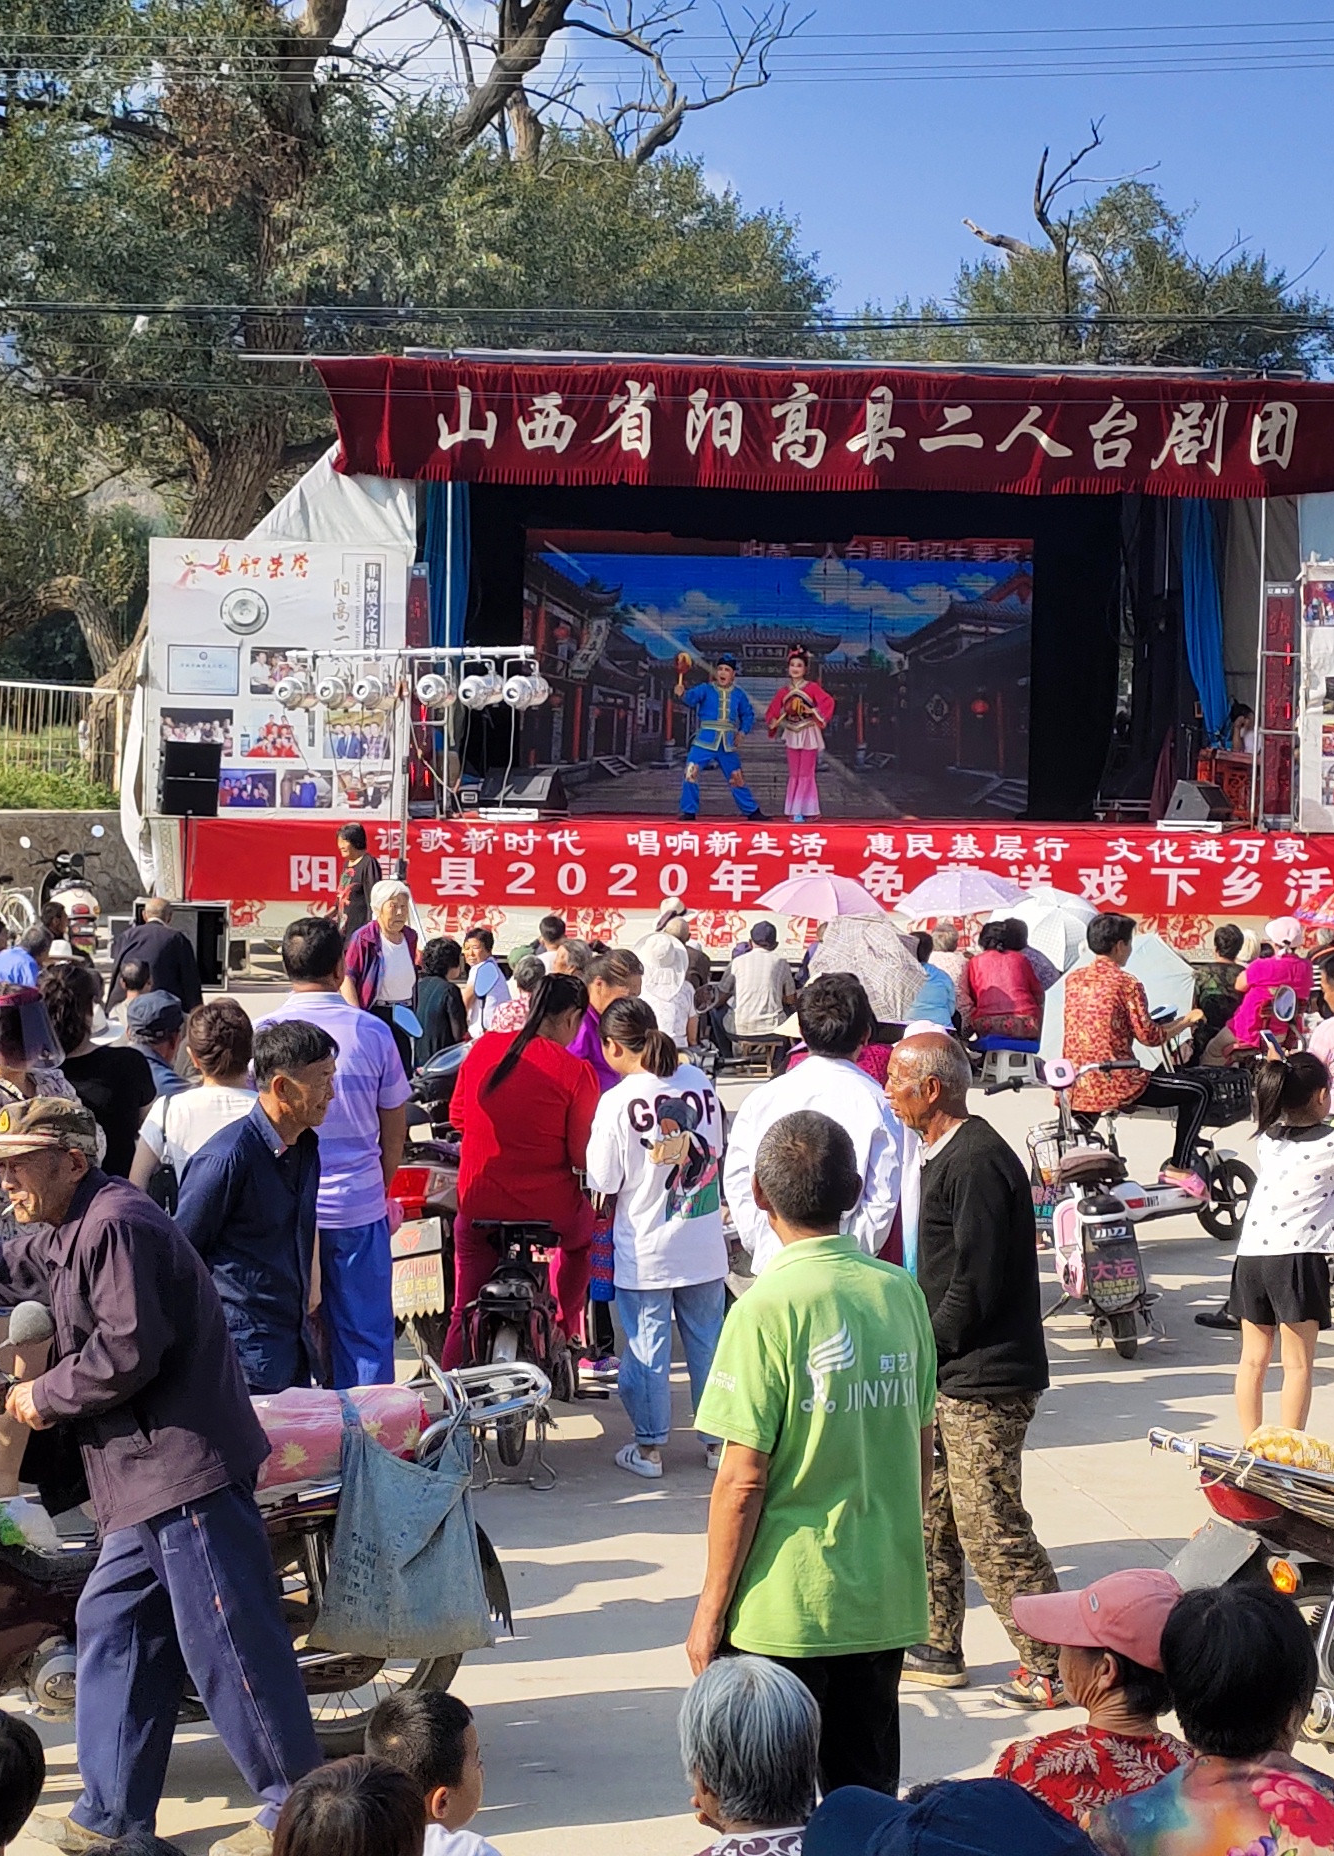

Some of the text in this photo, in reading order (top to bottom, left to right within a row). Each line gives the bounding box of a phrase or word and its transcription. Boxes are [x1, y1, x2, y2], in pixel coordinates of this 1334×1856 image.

[437, 380, 1298, 476] 山西省阳高县二人台剧团
[626, 831, 828, 857] 唱响新生活
[863, 832, 1070, 861] 惠民基层行
[1105, 837, 1310, 863] 文化进万家
[1095, 1226, 1127, 1239] 小刀
[1091, 1259, 1139, 1282] 大运
